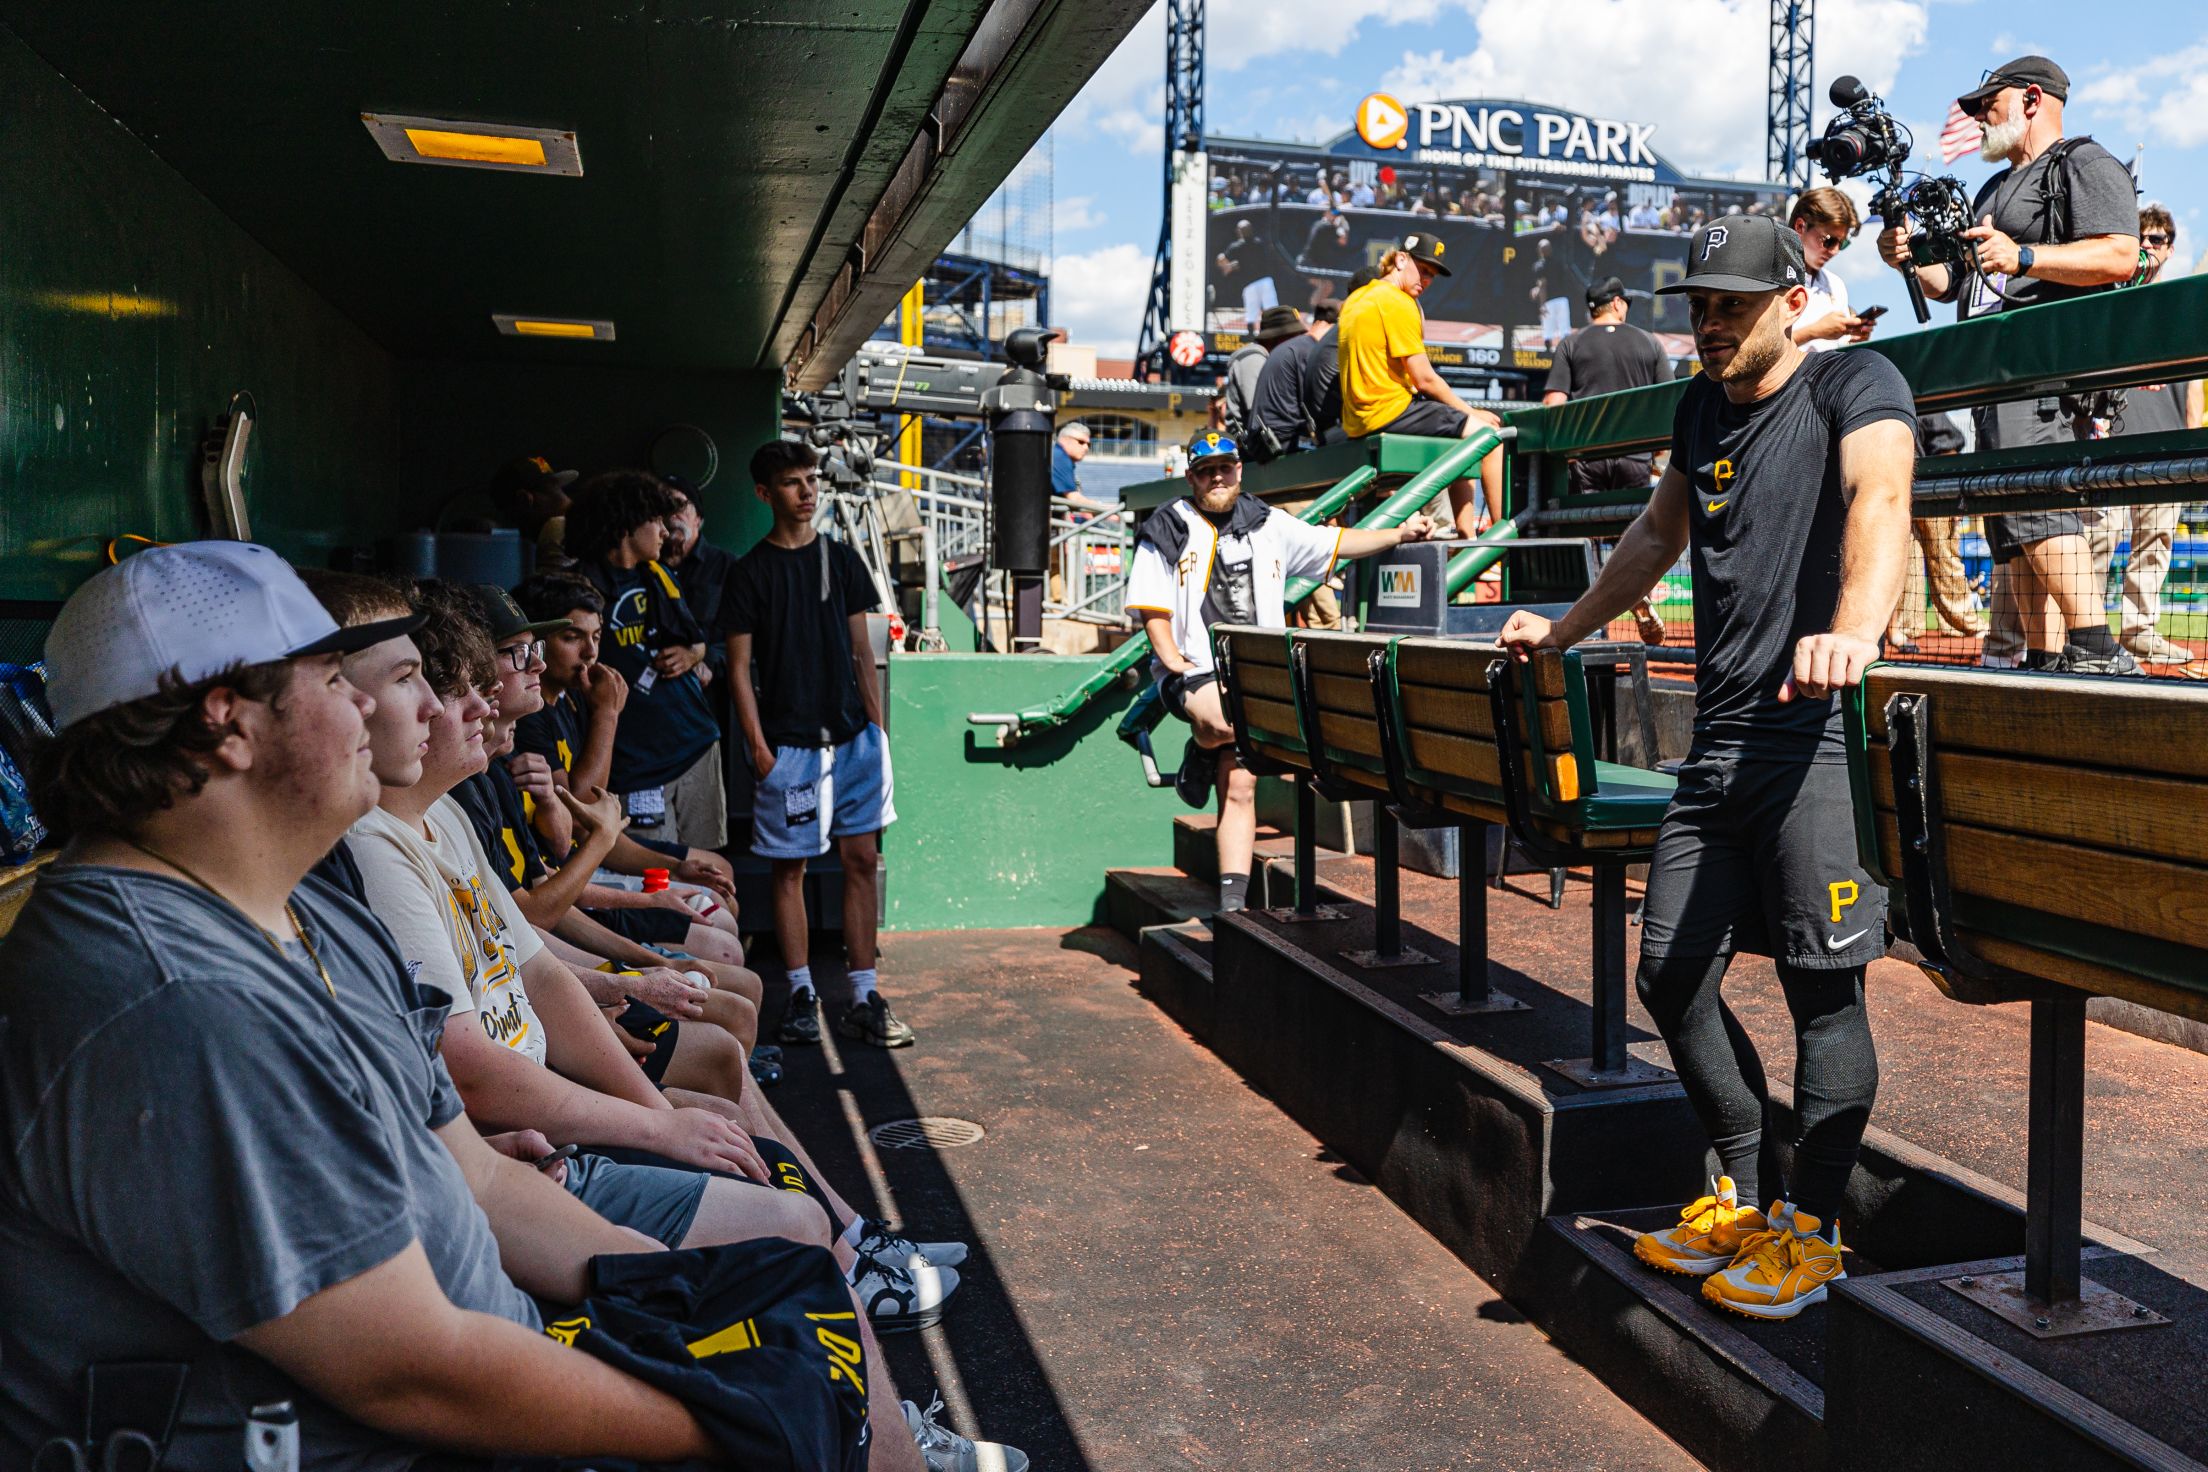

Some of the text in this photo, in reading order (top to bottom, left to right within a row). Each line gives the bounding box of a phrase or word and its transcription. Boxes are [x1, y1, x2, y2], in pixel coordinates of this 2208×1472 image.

[1414, 102, 1658, 166] PNC PARK
[1419, 148, 1656, 183] HOME OF THE PITTSBURGH PIRATES
[1434, 241, 1446, 257] P
[1699, 225, 1728, 261] P
[1503, 247, 1516, 264] P
[1467, 349, 1500, 366] 160
[825, 403, 833, 415] 2
[1169, 393, 1182, 416] P
[1714, 459, 1735, 491] P
[1381, 571, 1416, 593] WM
[1828, 879, 1859, 923] P
